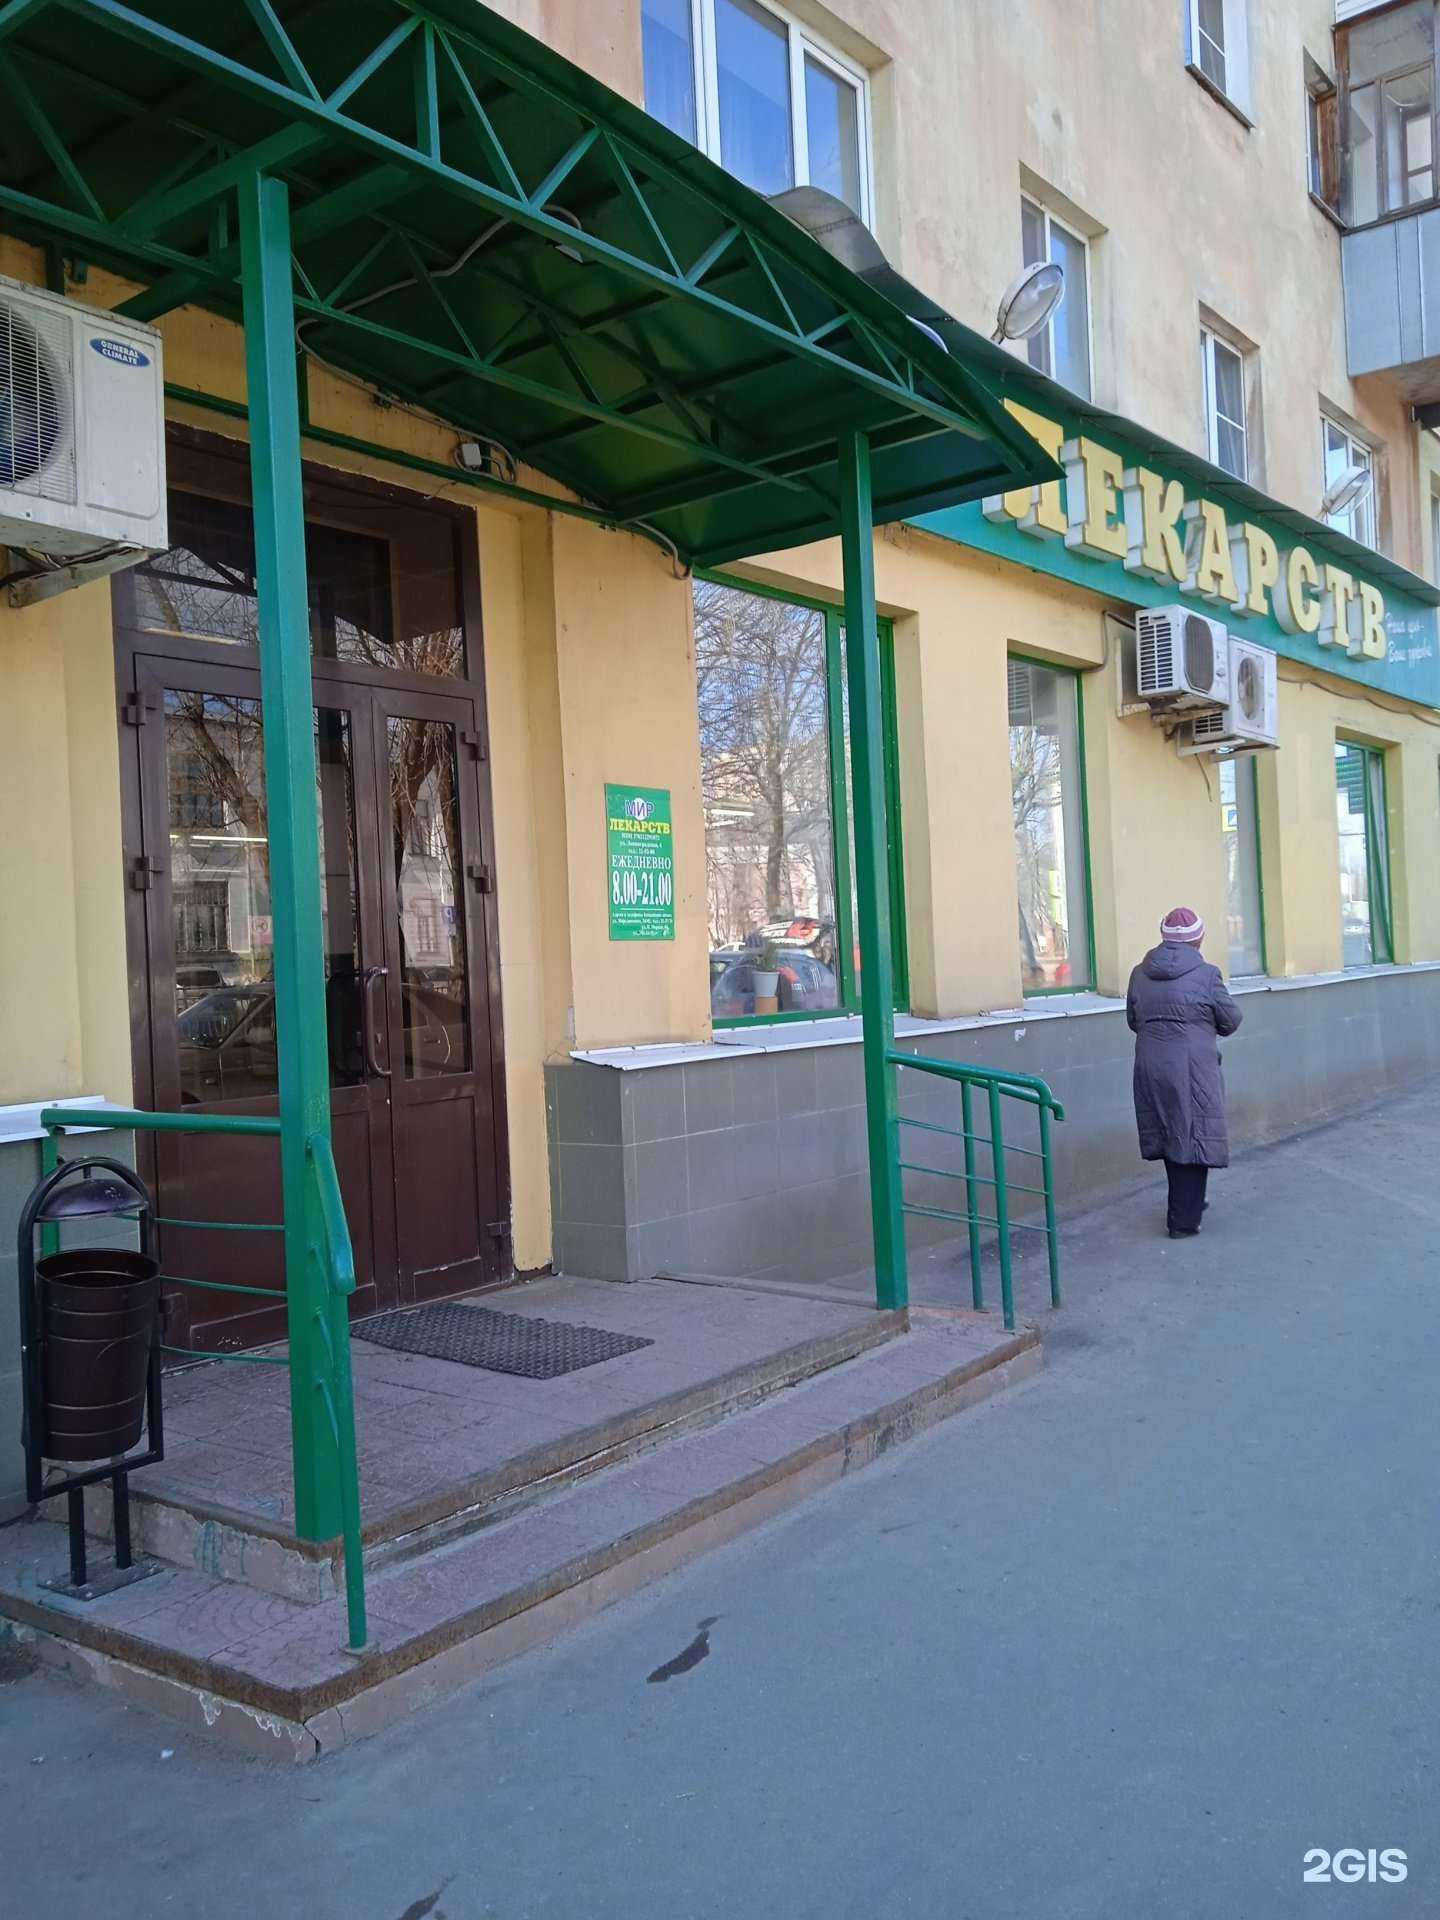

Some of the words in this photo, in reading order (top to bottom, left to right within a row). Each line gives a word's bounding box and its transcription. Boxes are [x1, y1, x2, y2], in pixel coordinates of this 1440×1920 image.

[101, 341, 138, 358] GENERAL
[102, 348, 137, 365] CLIMATE
[624, 799, 655, 818] МИР
[609, 818, 671, 834] ЛЕКАРСТВ
[612, 854, 672, 870] ЕЖЕДНЕВНО
[612, 870, 672, 906] 8.00-21.00
